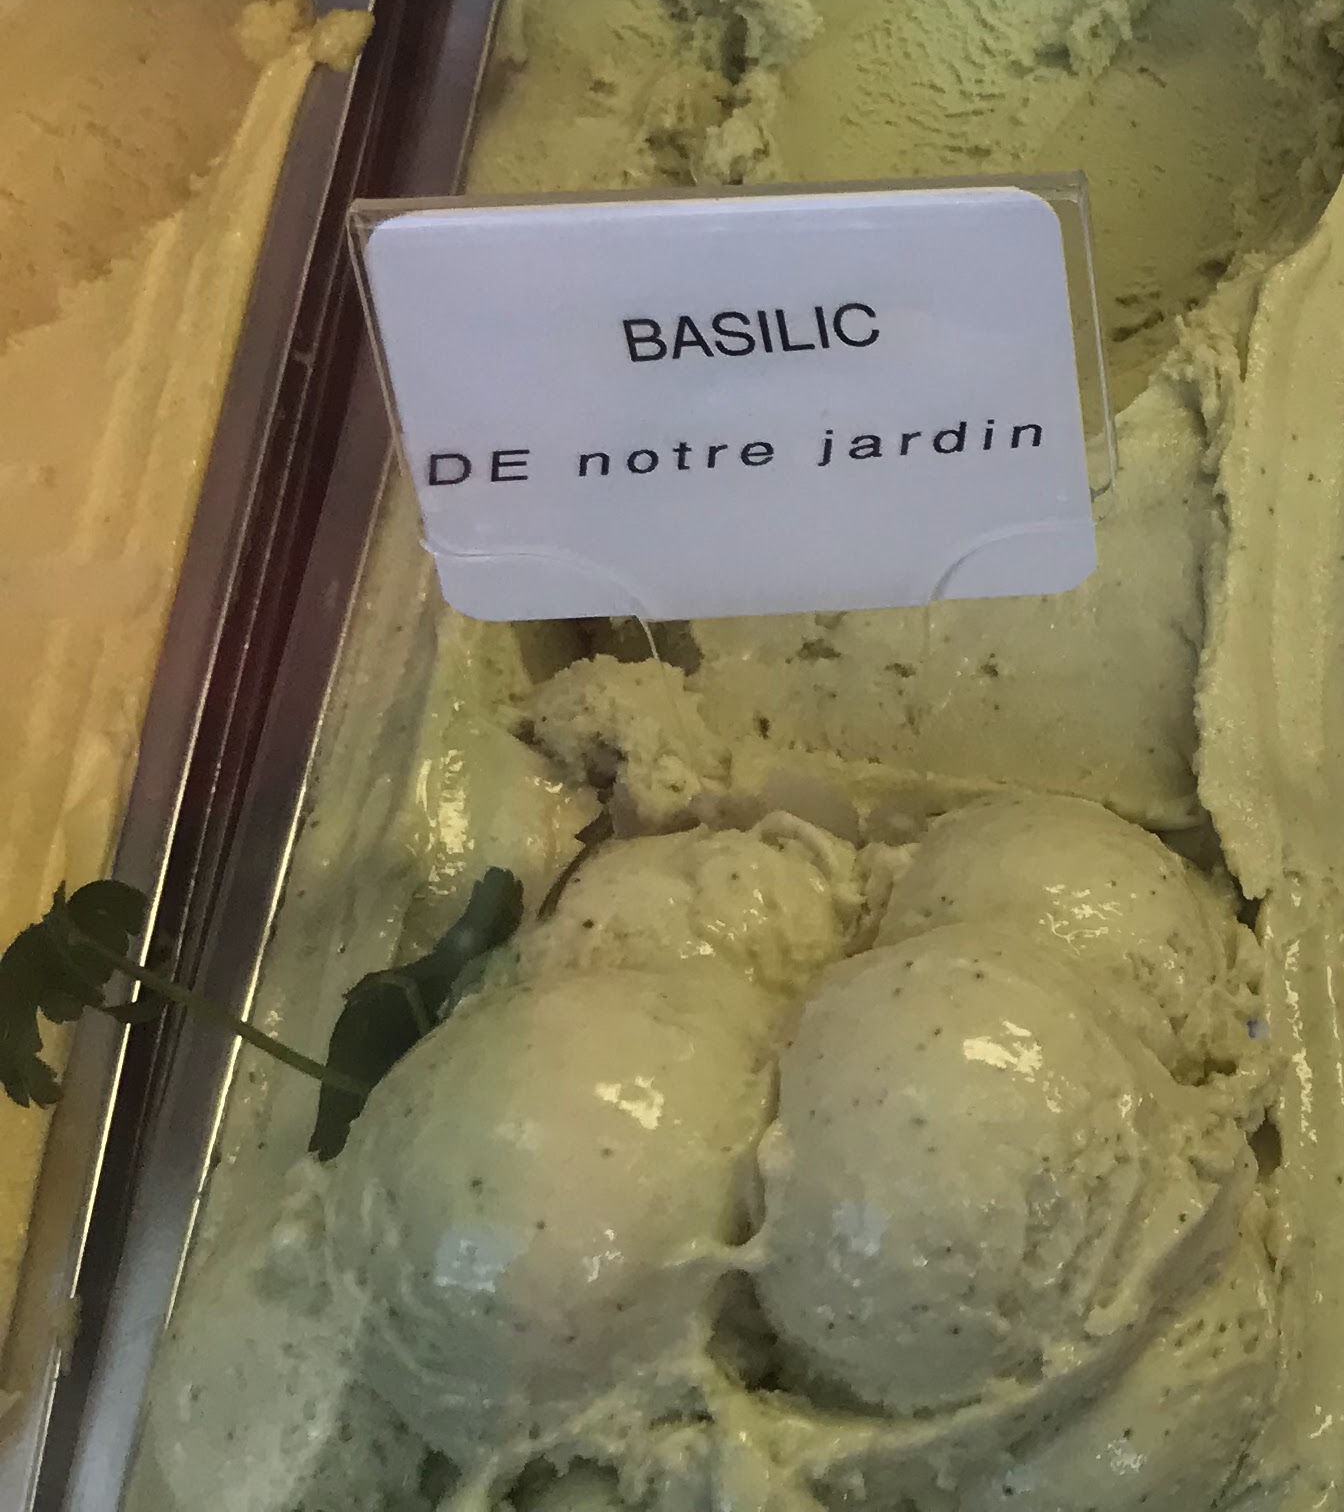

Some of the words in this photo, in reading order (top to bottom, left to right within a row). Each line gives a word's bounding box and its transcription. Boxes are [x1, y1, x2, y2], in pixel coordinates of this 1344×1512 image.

[622, 302, 880, 363] BASILIC
[427, 448, 531, 487] DE
[577, 437, 775, 478] notre
[817, 418, 1047, 468] jardin
